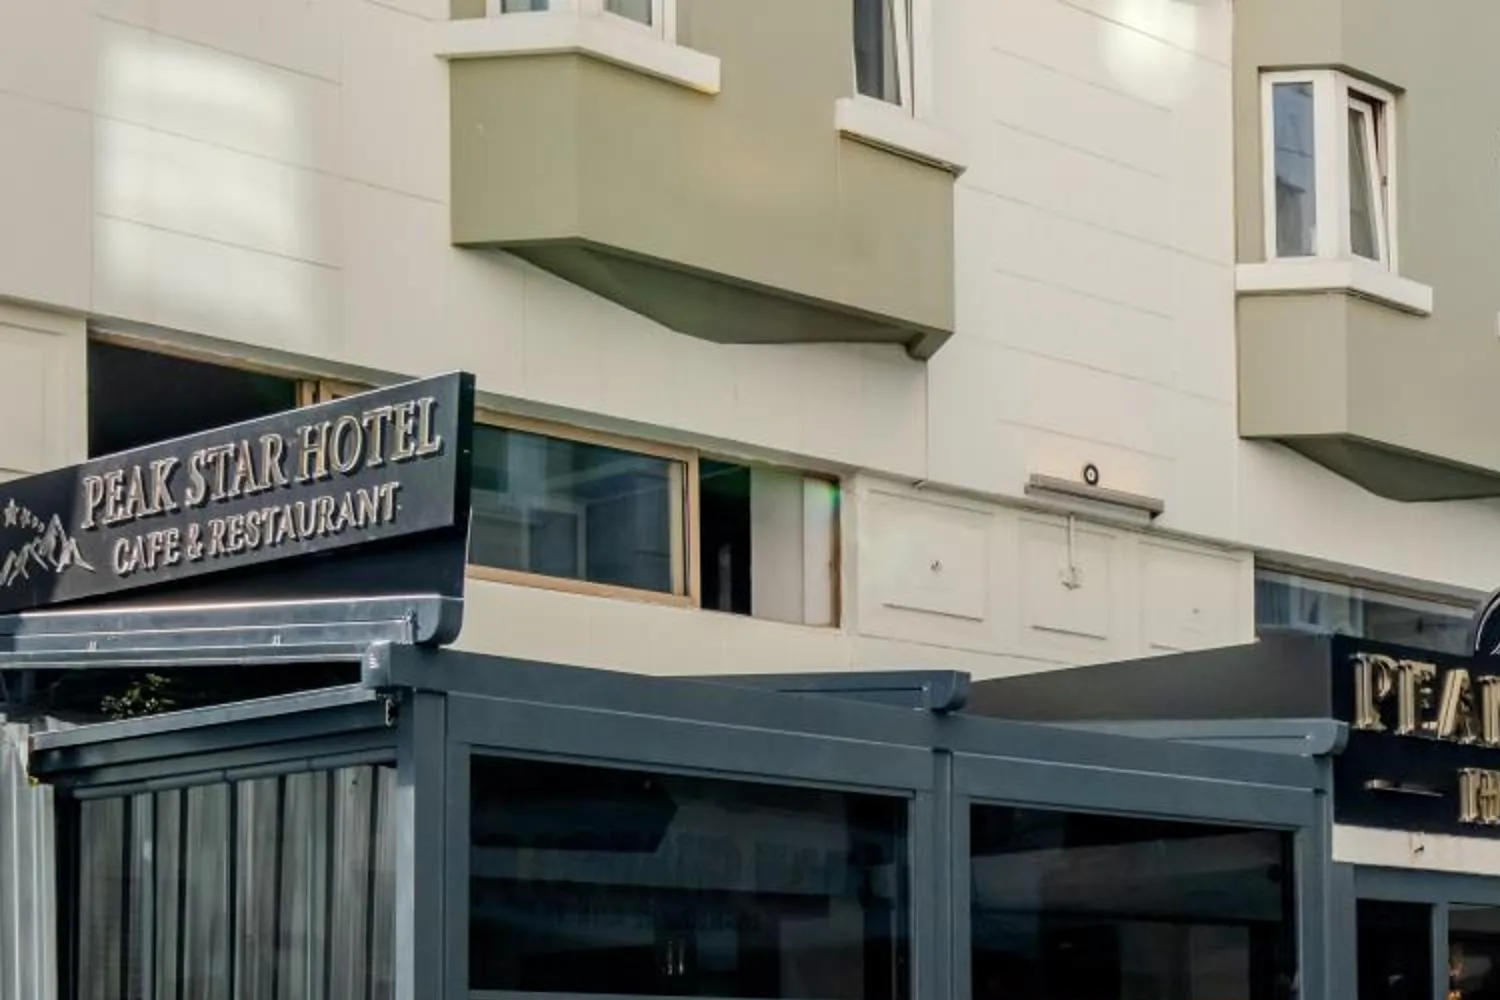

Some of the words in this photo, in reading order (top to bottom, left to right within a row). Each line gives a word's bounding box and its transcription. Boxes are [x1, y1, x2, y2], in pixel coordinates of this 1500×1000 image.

[81, 456, 181, 530] PEAK
[185, 432, 290, 506] STAR
[295, 396, 443, 483] HOTEL
[112, 526, 180, 577] CAFE
[185, 522, 205, 560] &
[208, 481, 401, 557] RESTAURANT
